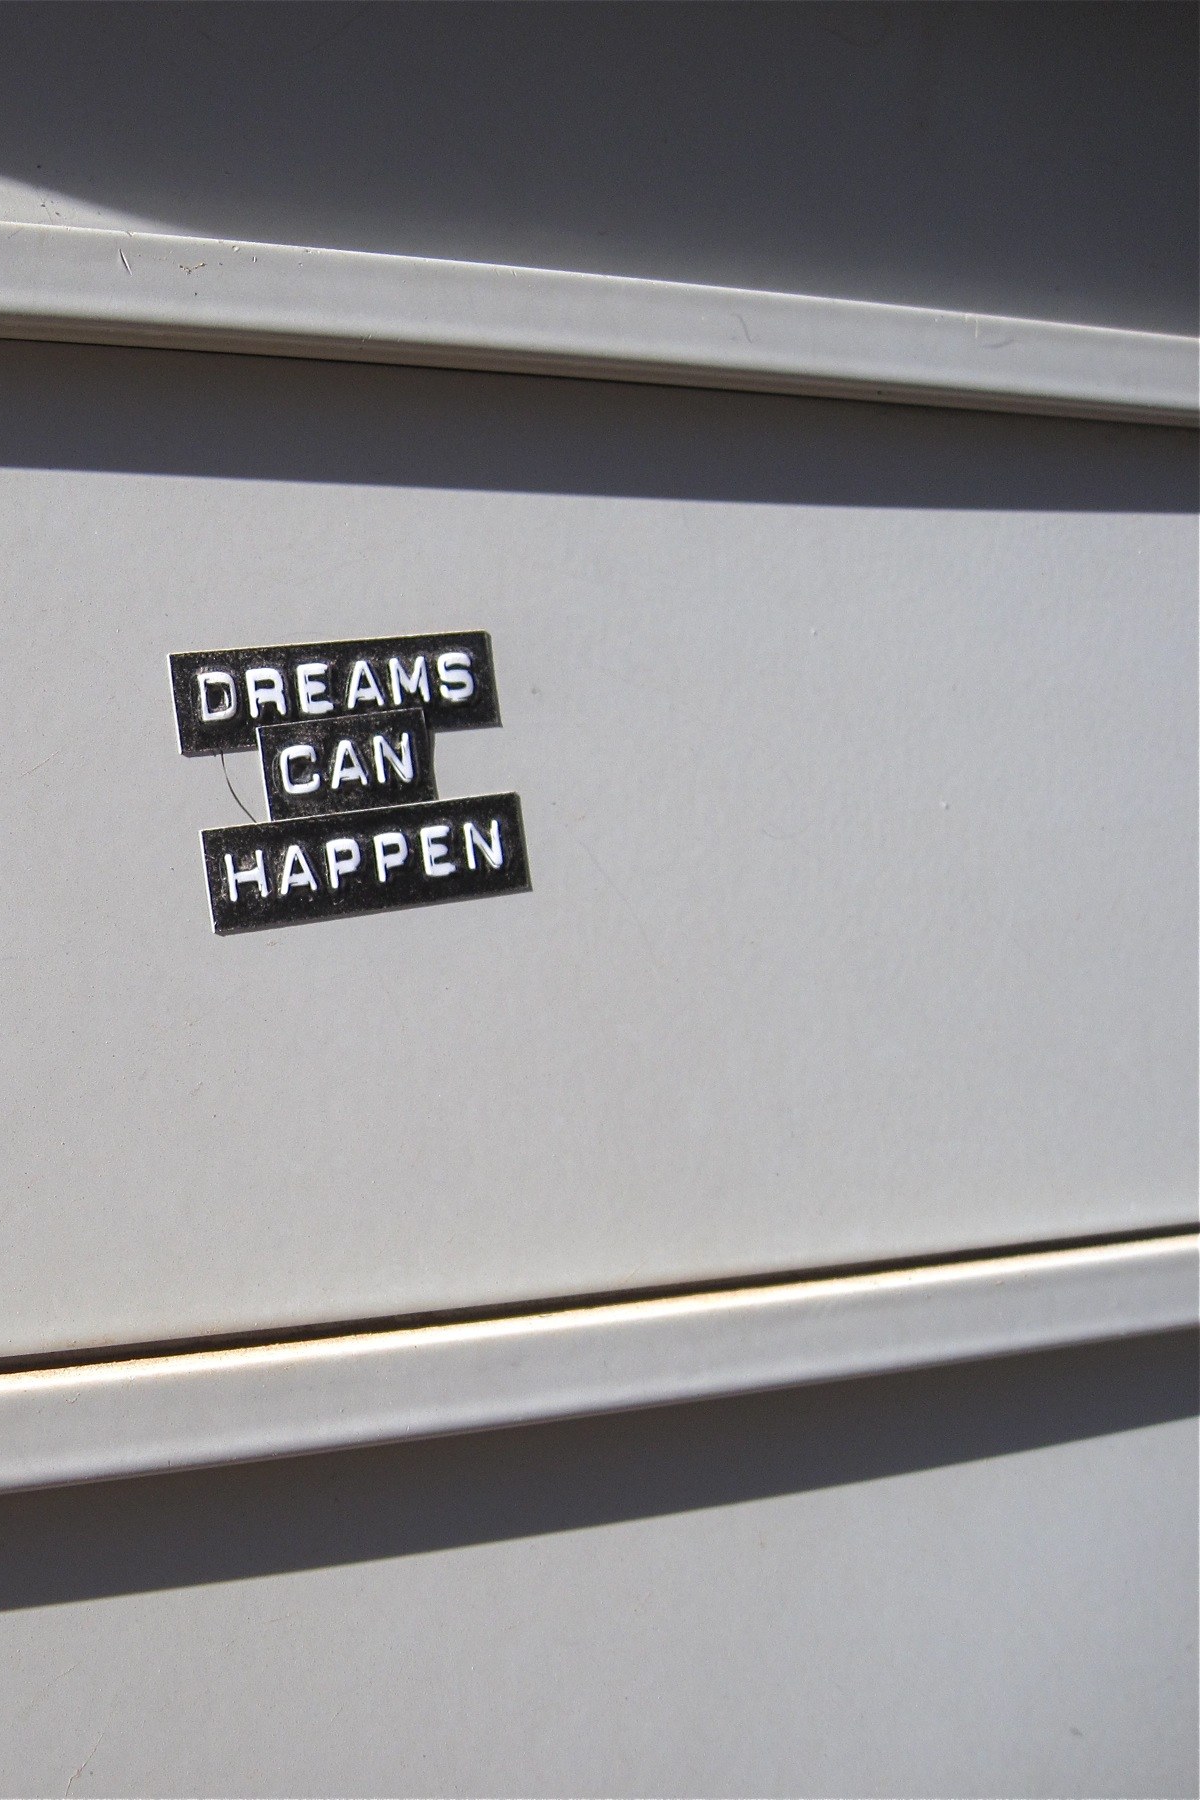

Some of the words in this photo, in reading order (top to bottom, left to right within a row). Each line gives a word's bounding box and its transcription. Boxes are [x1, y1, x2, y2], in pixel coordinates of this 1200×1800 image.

[196, 651, 475, 722] DREAMS
[279, 732, 415, 795] CAN
[224, 820, 504, 902] HAPPEN
